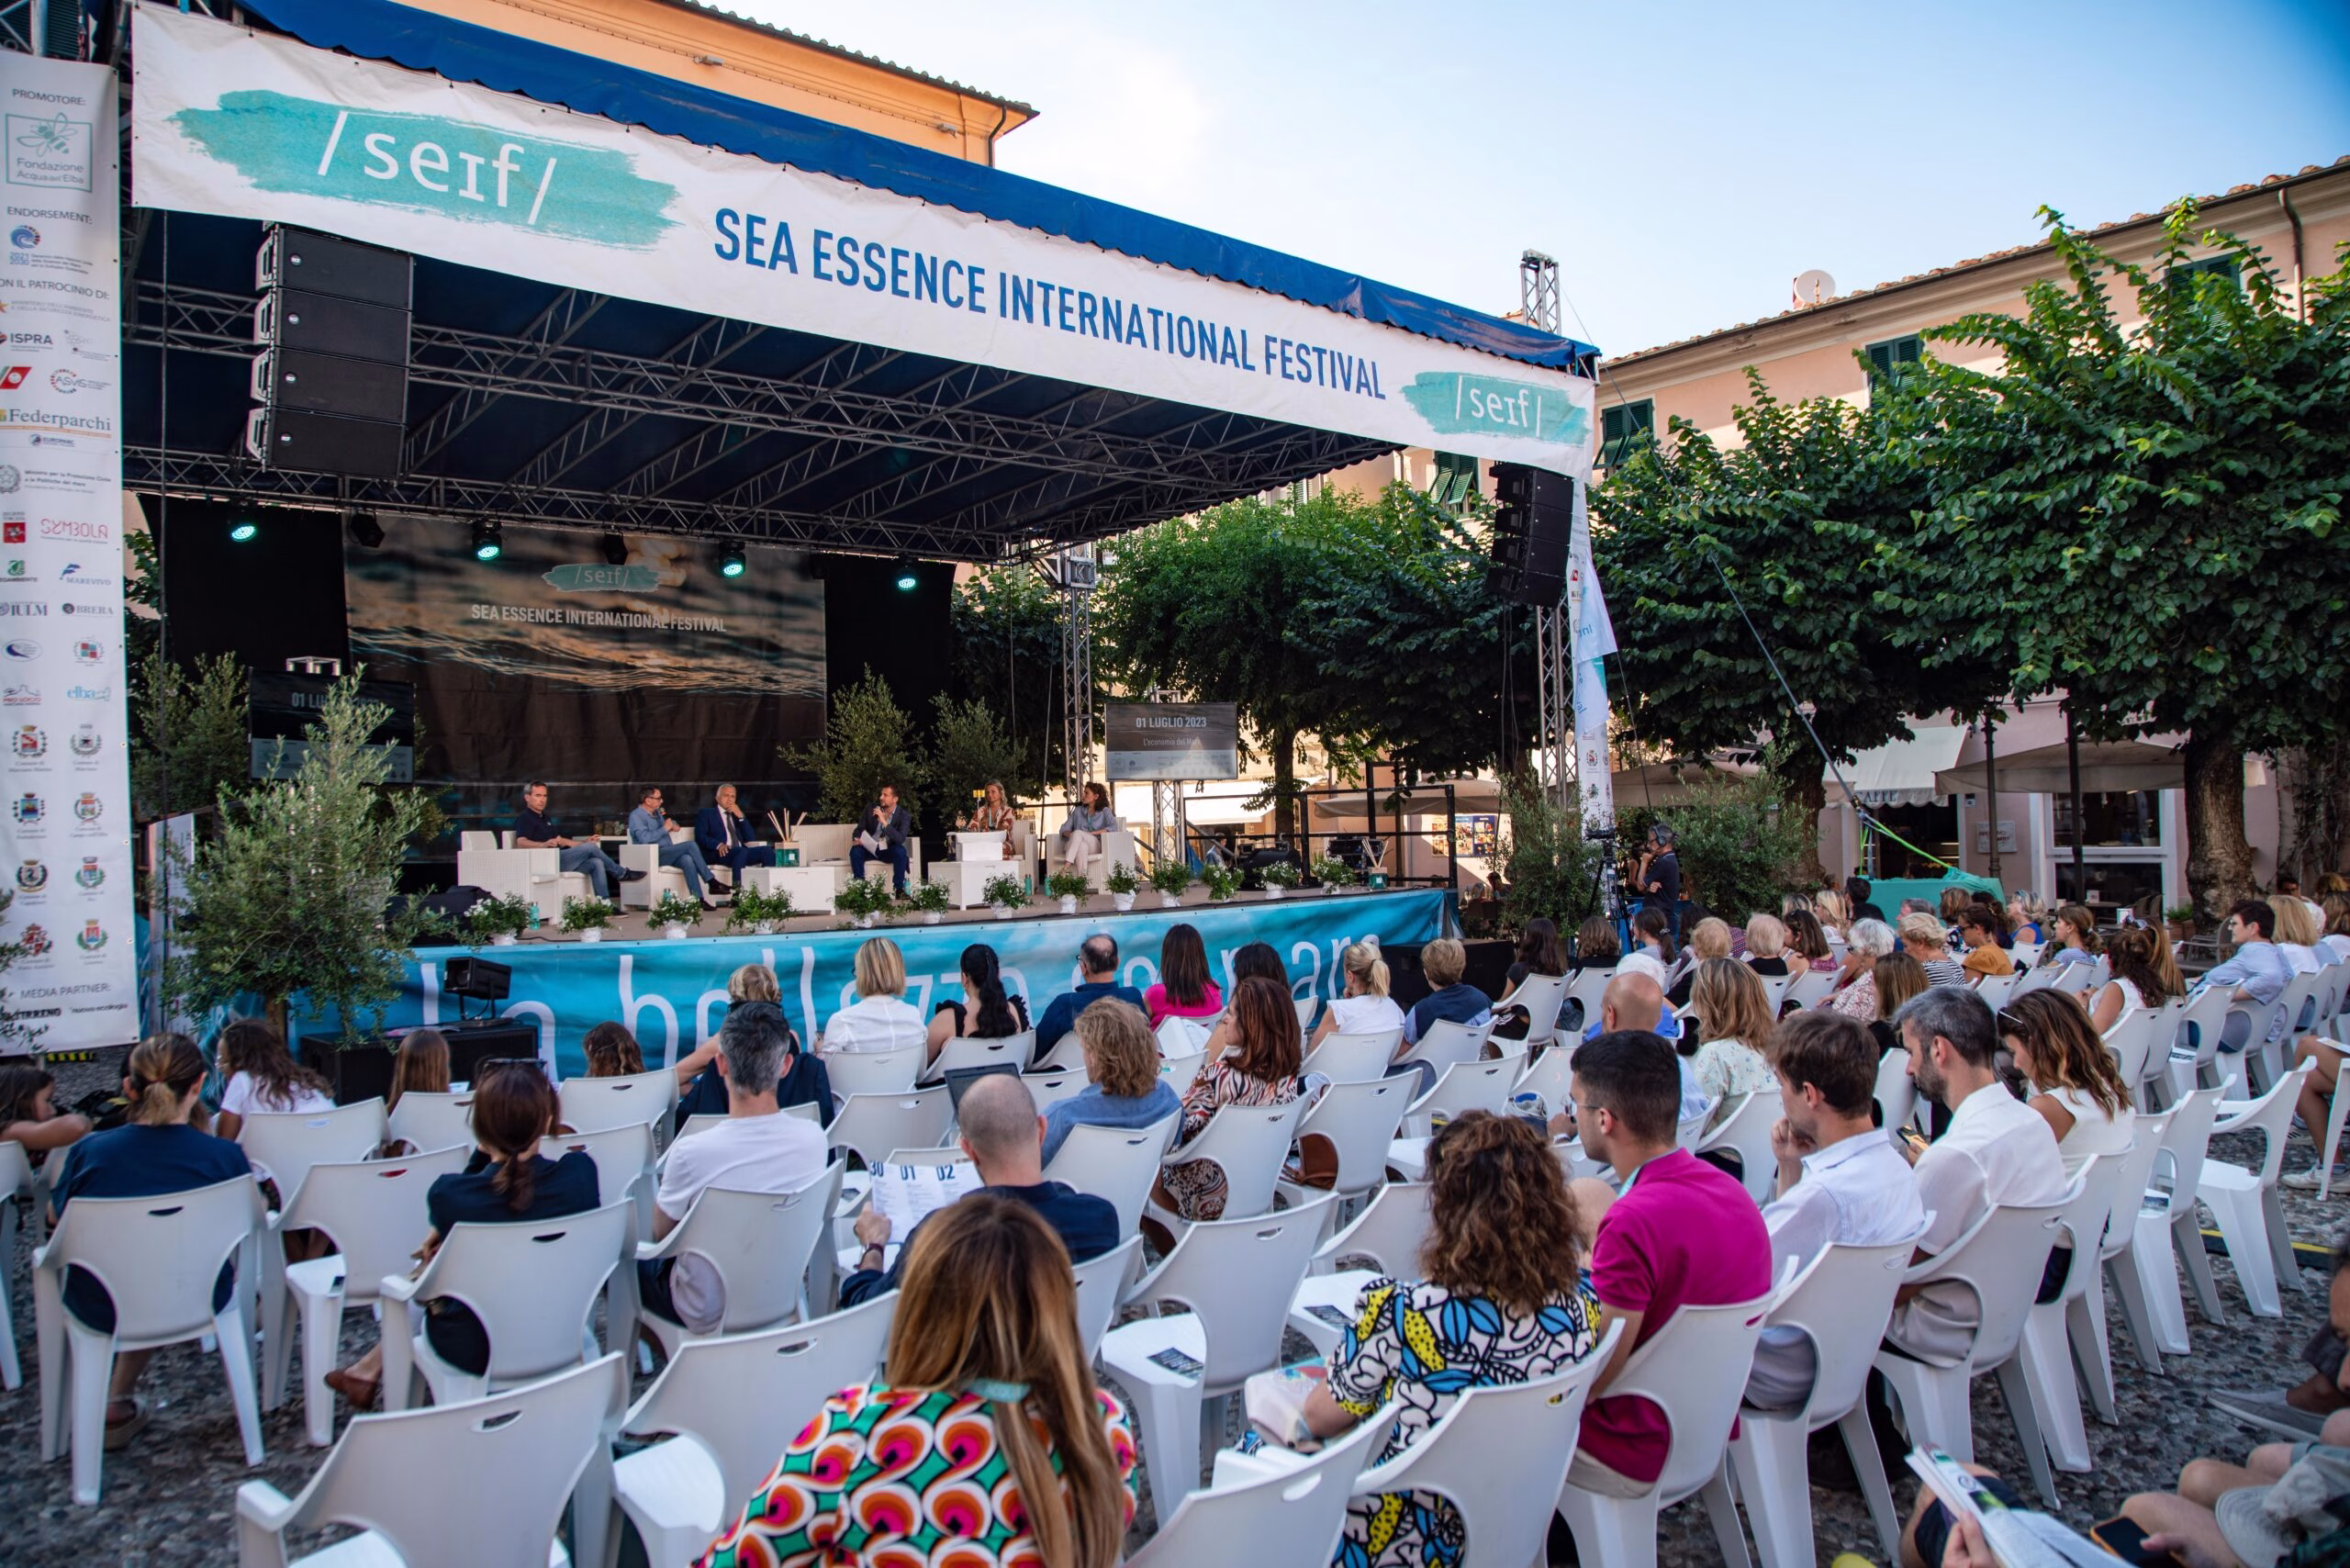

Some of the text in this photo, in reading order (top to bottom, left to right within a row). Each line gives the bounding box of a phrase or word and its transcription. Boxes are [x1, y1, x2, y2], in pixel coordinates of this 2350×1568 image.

[12, 88, 86, 106] PROMOTORE:
[17, 158, 84, 173] Fondazione
[6, 206, 93, 225] ENDORSEMENT:
[0, 278, 14, 287] ON
[17, 279, 26, 288] IL
[28, 280, 94, 297] PATROCINIO
[714, 207, 1387, 400] SEA ESSENCE INTERNATIONAL FESTIVAL
[10, 333, 53, 345] ISPRA
[9, 409, 111, 431] Federparchi
[40, 518, 108, 539] SYMBOLA
[66, 577, 111, 586] MAREVIVO
[11, 604, 48, 616] IULM
[76, 605, 114, 615] BRERA
[472, 604, 727, 633] SEA ESSENCE INTERNATIONAL FESTIVAL
[1136, 716, 1207, 728] 01 LUGLIO 2023
[1143, 737, 1175, 746] L'economia
[20, 982, 111, 1000] MEDIA PARTNER:
[870, 1160, 884, 1178] 30
[901, 1165, 916, 1182] 01
[936, 1165, 956, 1182] 02
